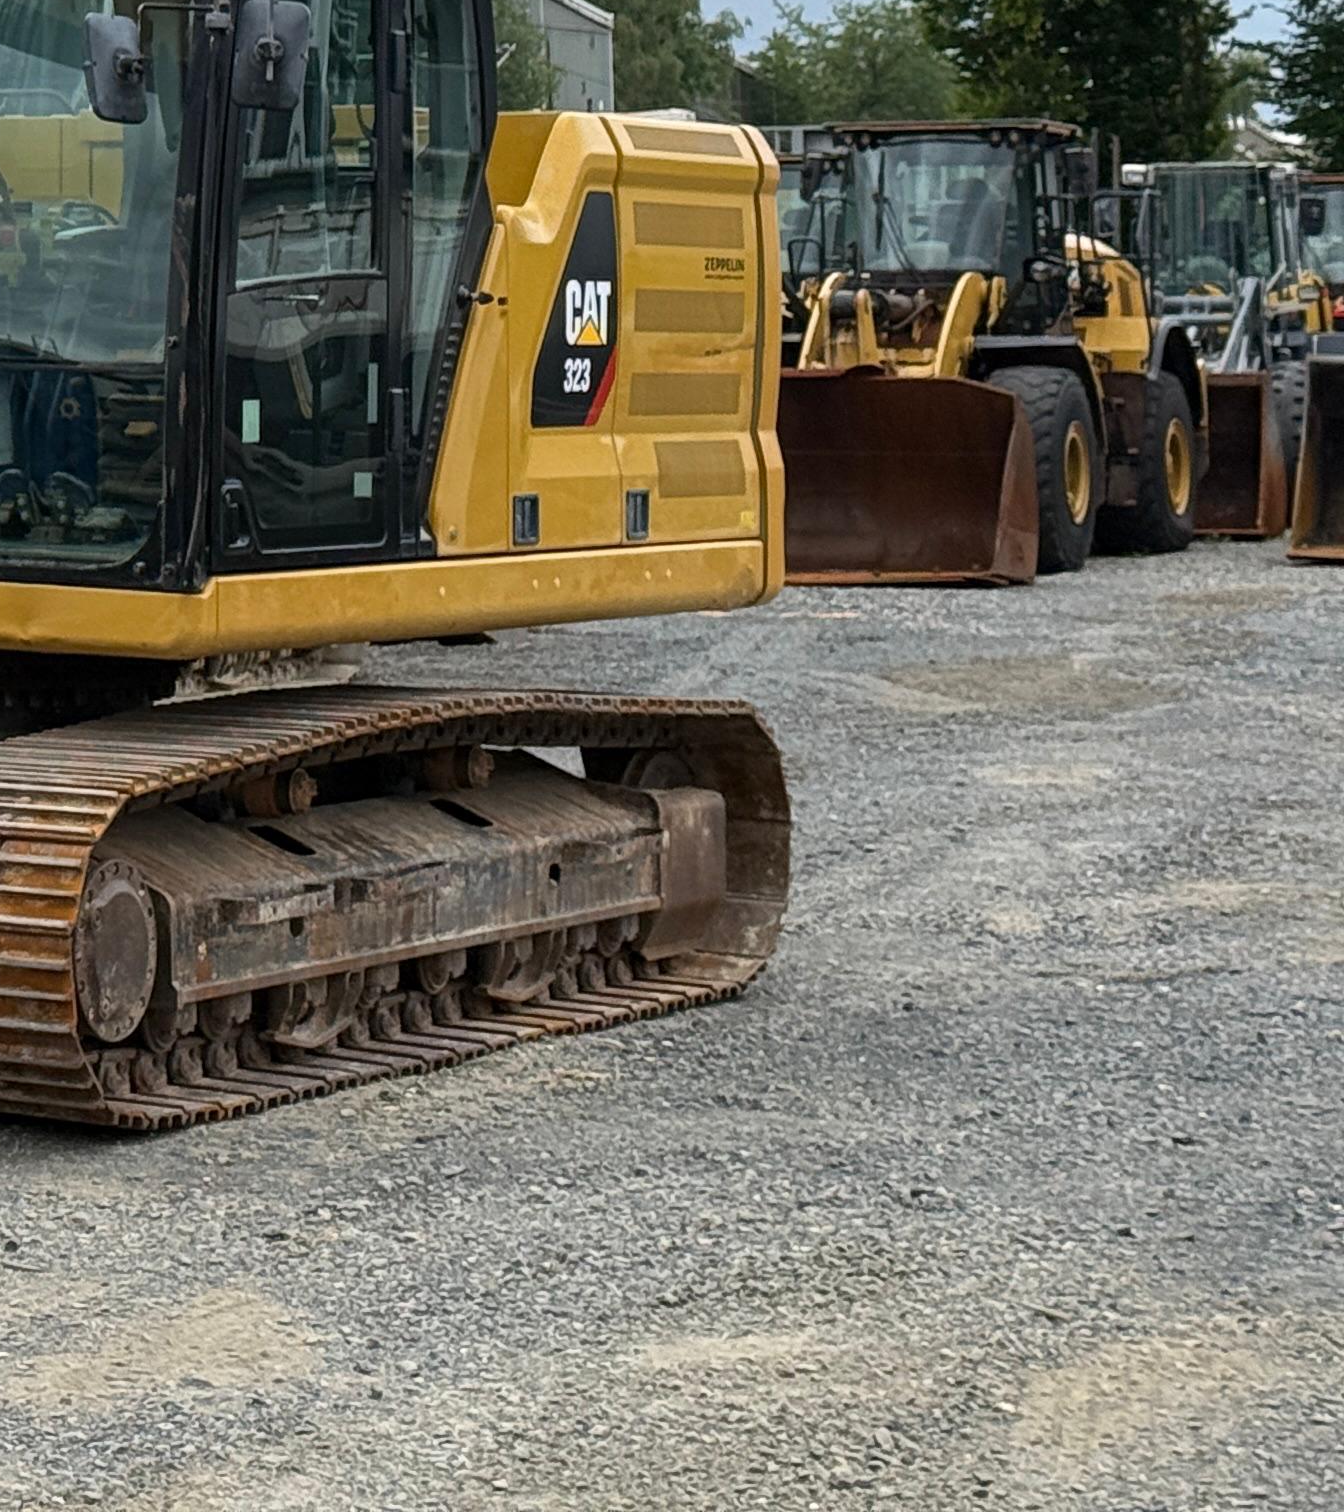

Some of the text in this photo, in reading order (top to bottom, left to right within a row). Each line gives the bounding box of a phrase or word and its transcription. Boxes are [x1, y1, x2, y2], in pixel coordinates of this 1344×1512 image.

[704, 256, 745, 272] ZEPPELIN
[565, 279, 611, 346] CAT
[563, 357, 592, 394] 323
